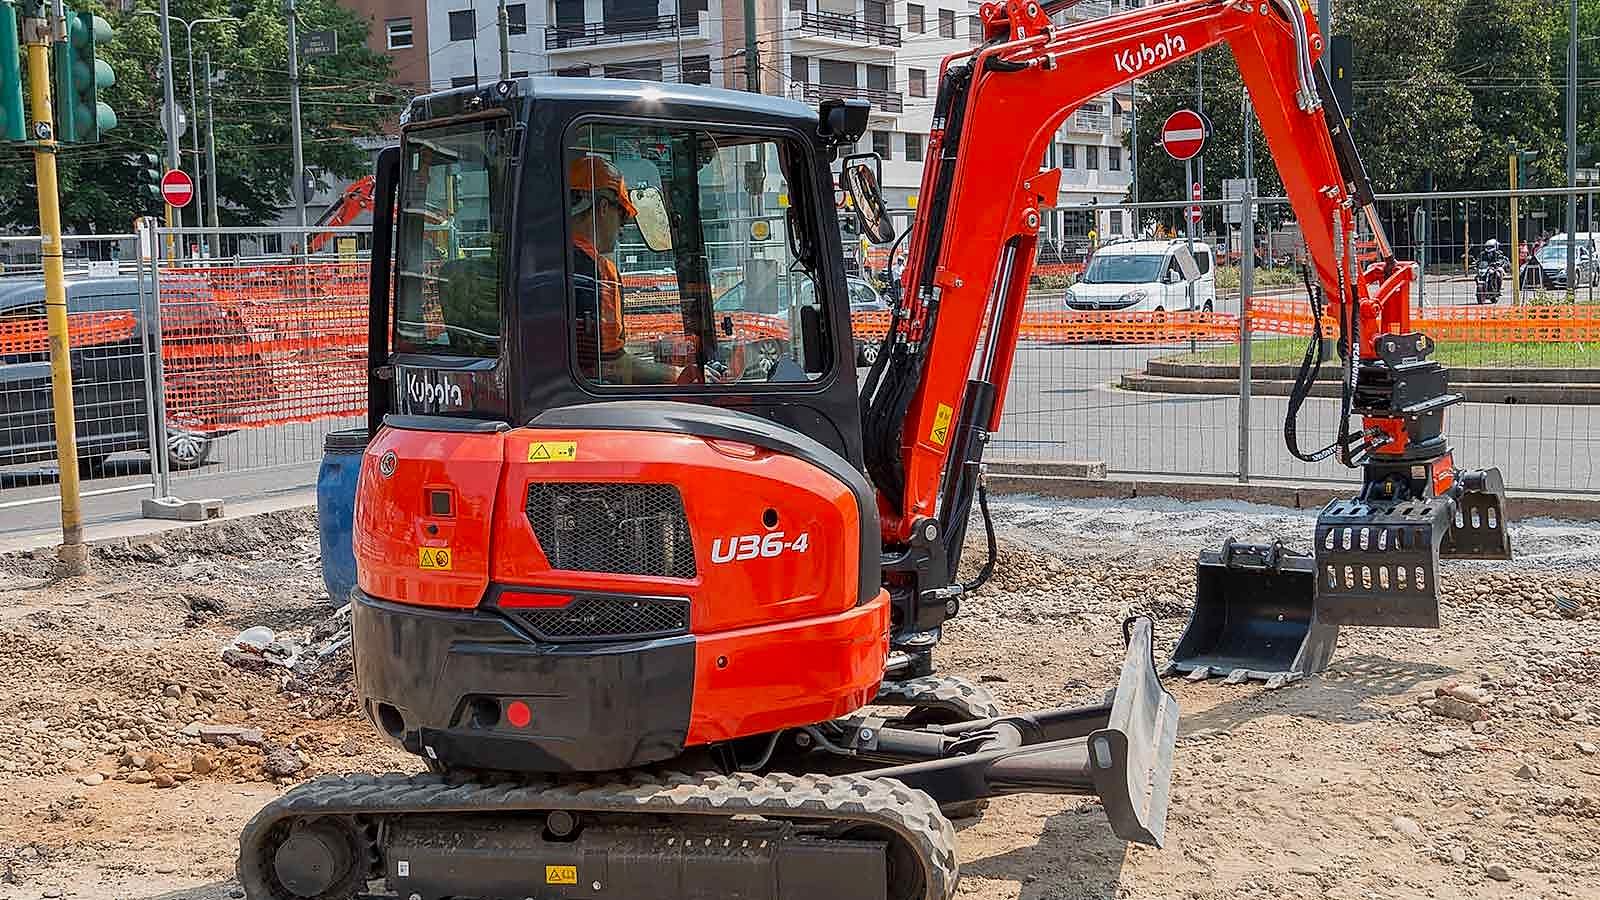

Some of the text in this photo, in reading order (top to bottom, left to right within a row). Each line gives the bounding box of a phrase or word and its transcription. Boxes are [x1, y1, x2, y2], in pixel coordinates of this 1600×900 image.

[1114, 32, 1186, 74] Kubota
[407, 373, 463, 406] Kubota
[711, 531, 809, 564] U36-4
